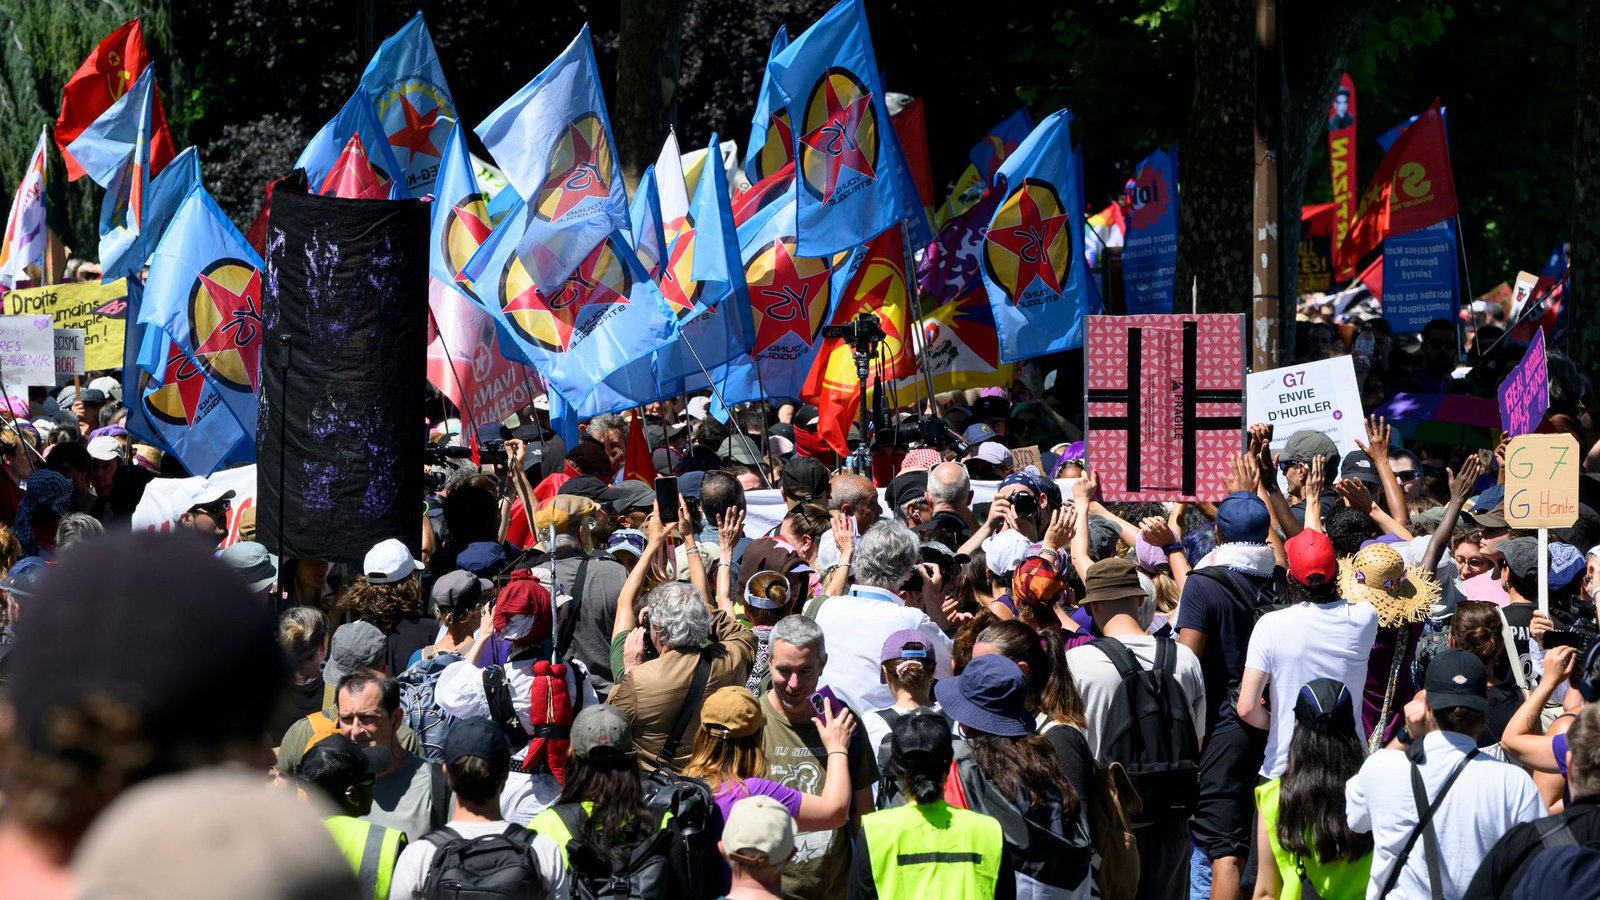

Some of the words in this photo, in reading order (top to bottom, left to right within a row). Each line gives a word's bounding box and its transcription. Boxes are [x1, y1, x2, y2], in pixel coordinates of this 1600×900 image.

[12, 290, 57, 315] Droits
[44, 300, 99, 322] umains
[1283, 371, 1306, 388] G7
[1279, 388, 1315, 404] ENVIE
[1174, 394, 1183, 440] FRAGILE
[1268, 401, 1332, 422] D'HURLER
[1509, 489, 1530, 519] G
[1539, 489, 1576, 518] Honte
